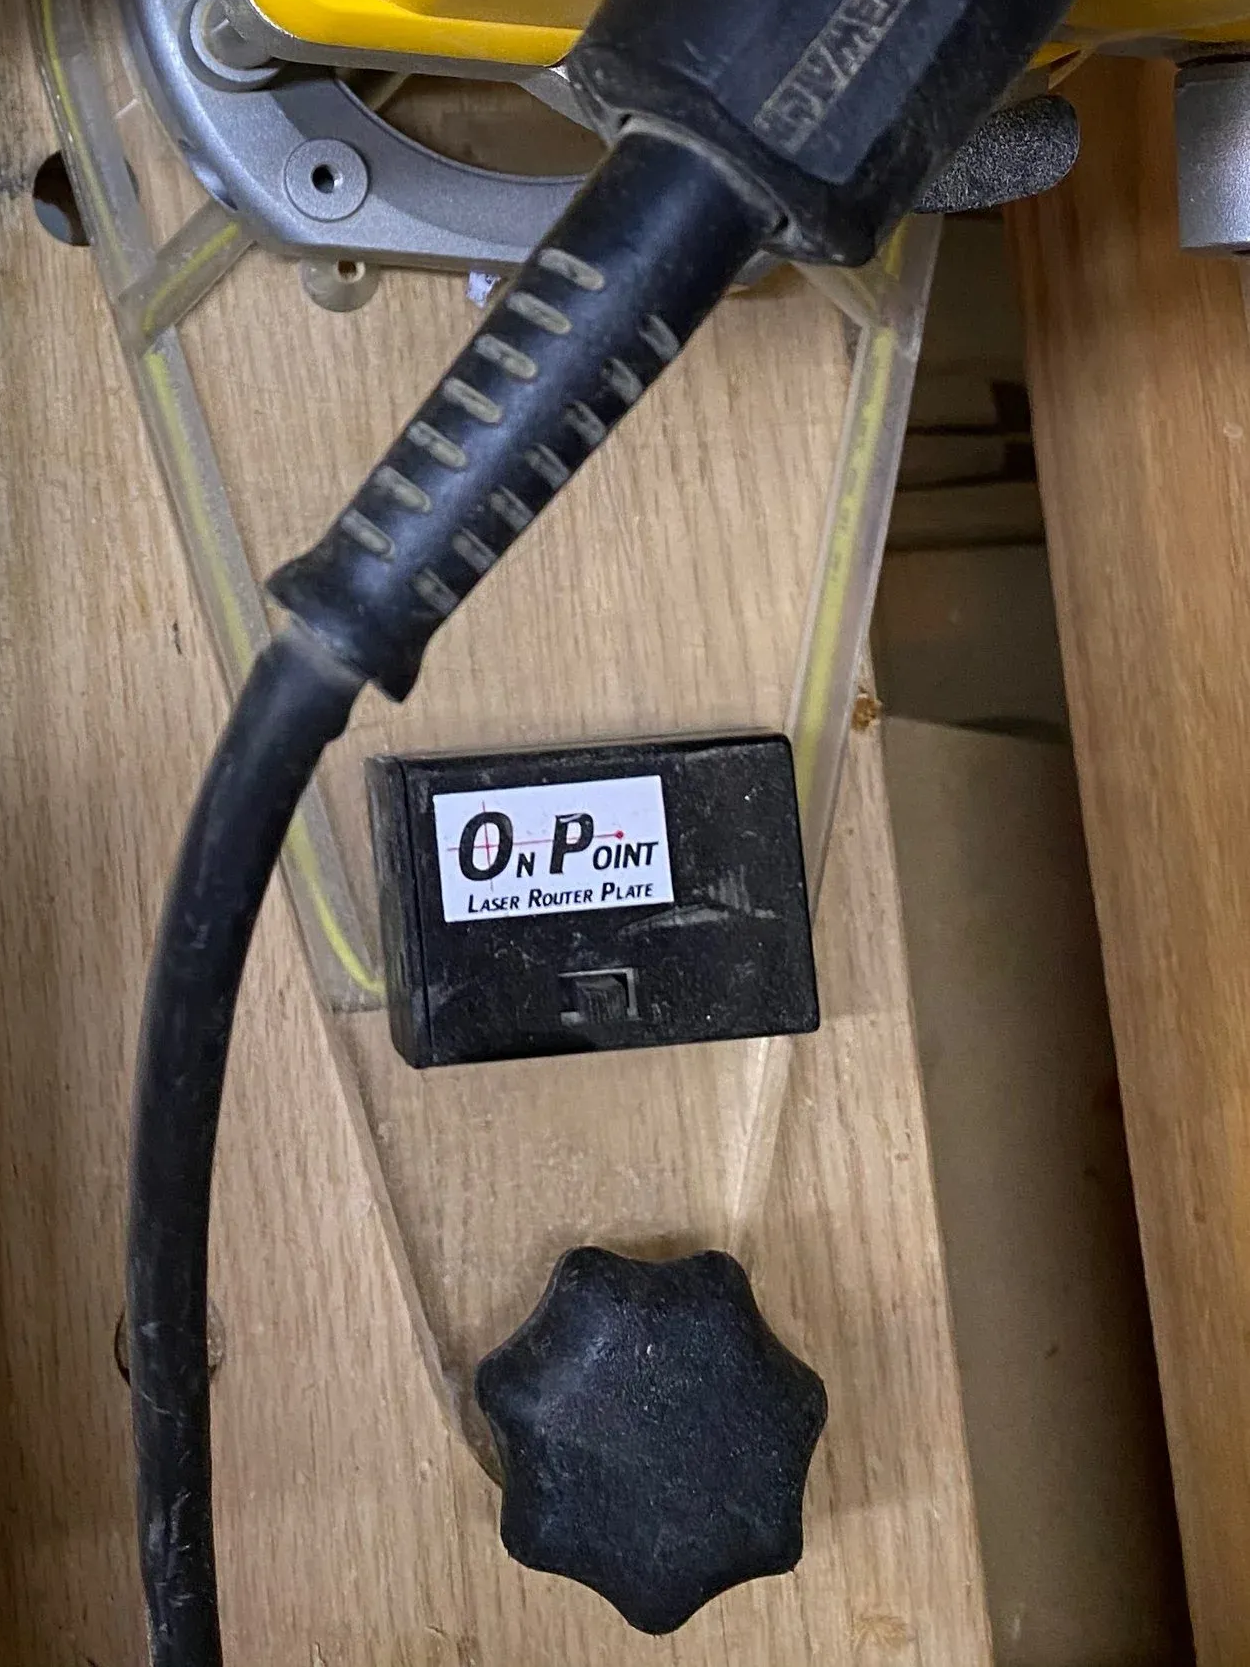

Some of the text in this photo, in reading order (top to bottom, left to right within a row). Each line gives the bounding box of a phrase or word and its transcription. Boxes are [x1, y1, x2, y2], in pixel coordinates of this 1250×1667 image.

[549, 813, 658, 875] POINT
[468, 882, 654, 914] LASER ROUTER PLATE
